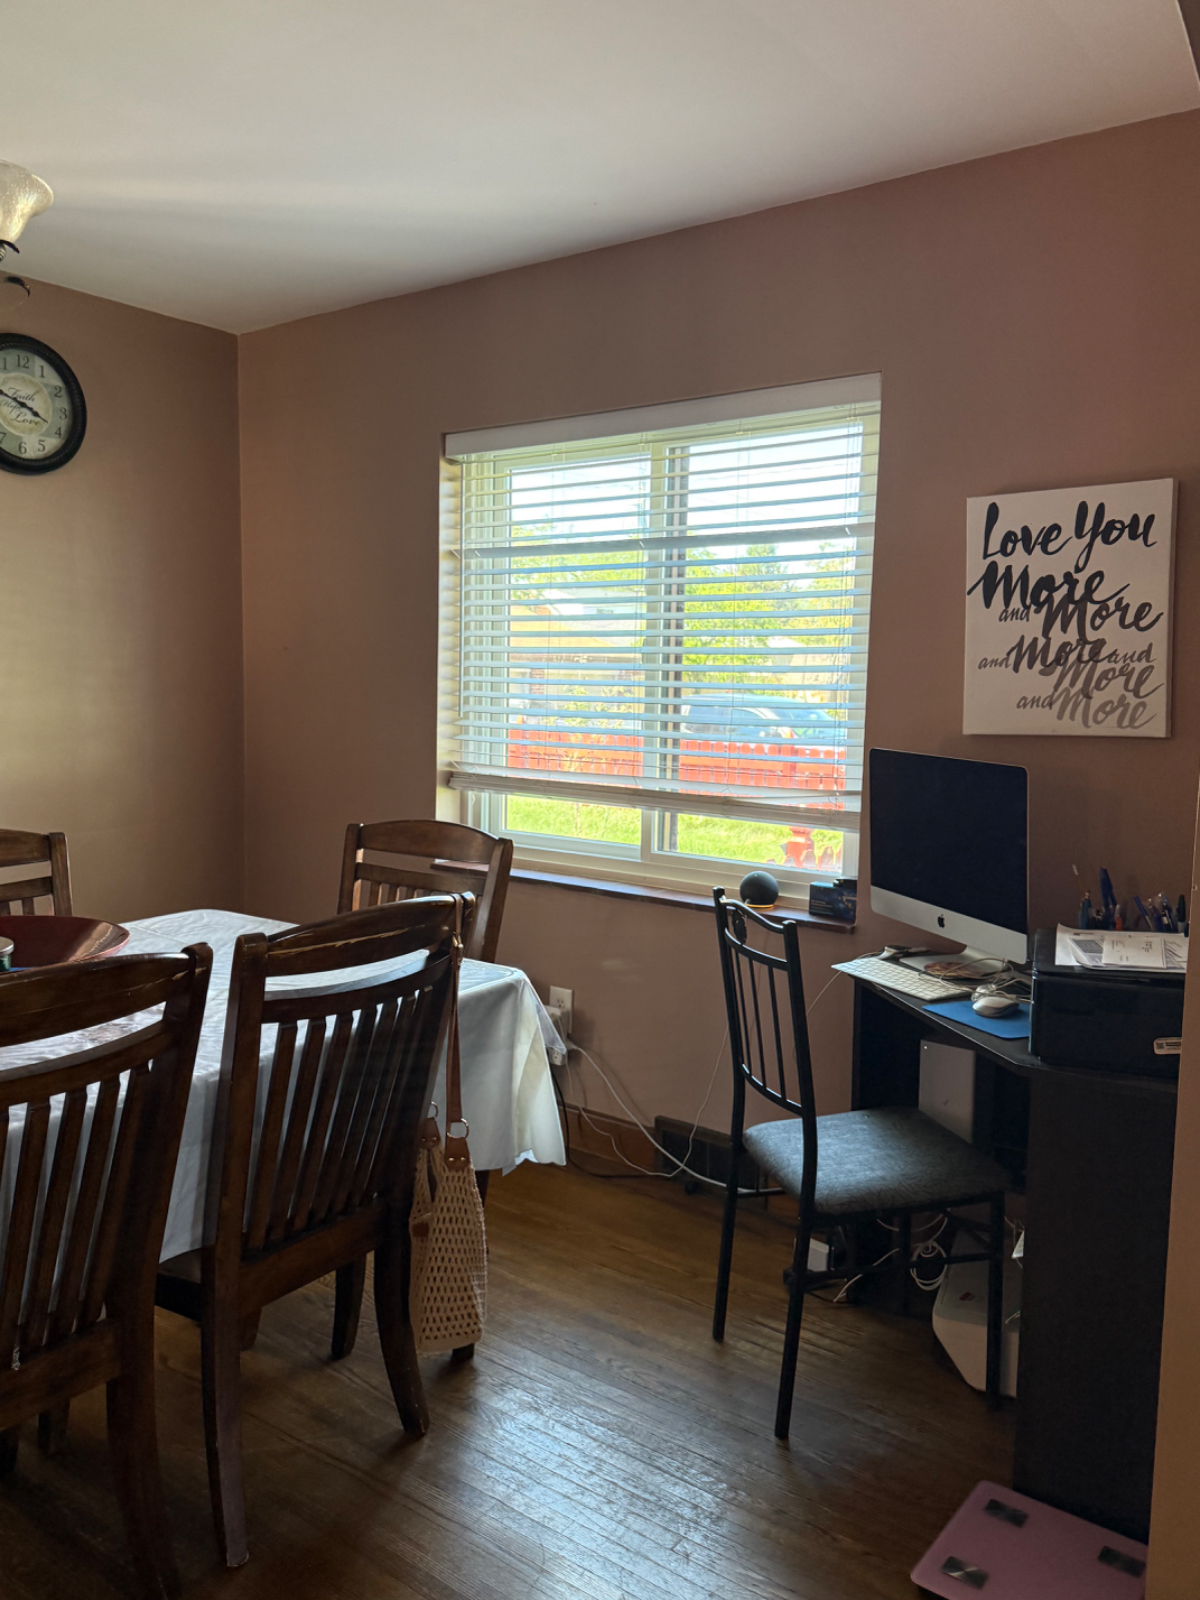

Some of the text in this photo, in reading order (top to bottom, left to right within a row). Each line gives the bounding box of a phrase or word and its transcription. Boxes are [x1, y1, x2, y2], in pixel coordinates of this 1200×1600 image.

[17, 355, 30, 369] 12
[39, 365, 46, 379] 1
[8, 388, 39, 402] Faith
[54, 386, 62, 398] 2
[10, 411, 40, 426] Love
[59, 408, 67, 420] 3
[54, 427, 62, 439] 4
[18, 443, 28, 455] 6
[38, 440, 46, 453] 5
[983, 500, 1158, 573] Love You
[967, 561, 1130, 614] More
[998, 592, 1164, 645] and More
[978, 634, 1156, 673] and More and
[1038, 658, 1165, 699] More
[1016, 687, 1157, 729] and More
